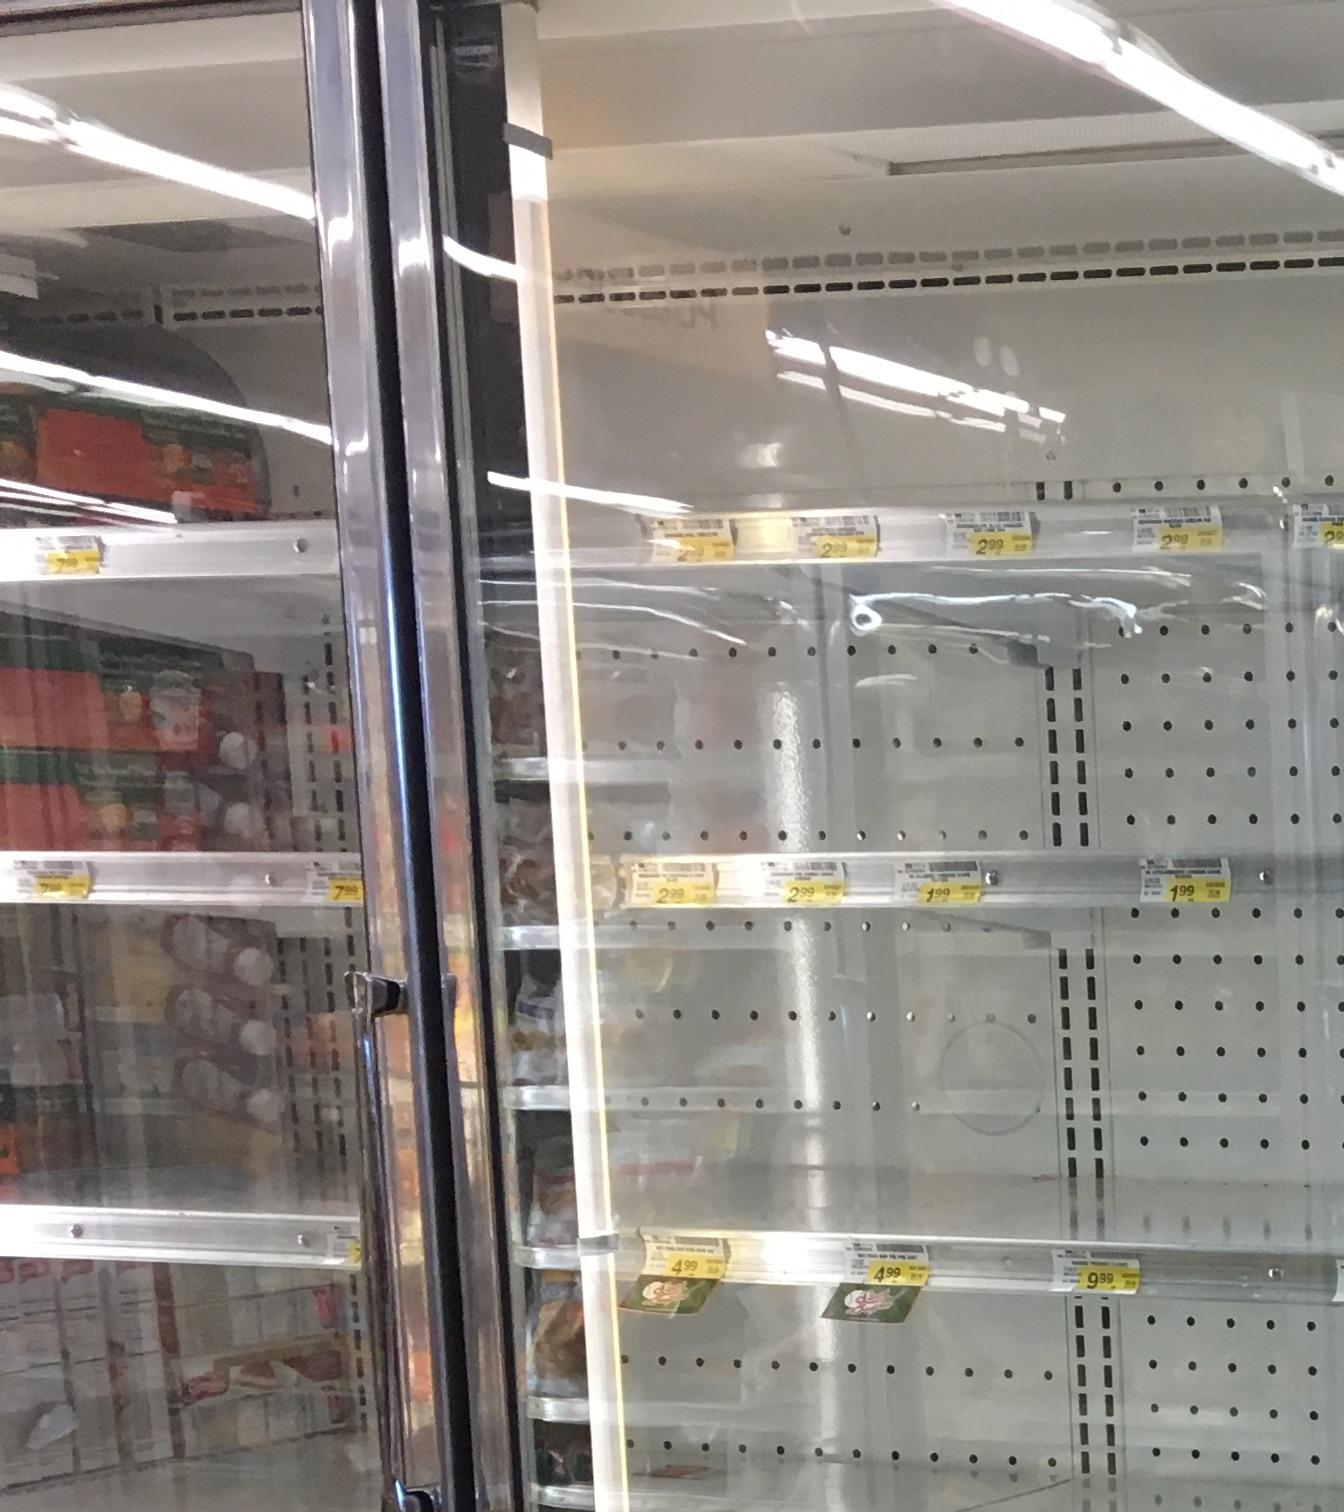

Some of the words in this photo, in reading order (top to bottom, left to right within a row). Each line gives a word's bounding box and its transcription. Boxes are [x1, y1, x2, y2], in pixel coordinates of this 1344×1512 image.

[976, 538, 1004, 555] 299
[787, 886, 815, 902] 299
[1170, 884, 1195, 902] 199
[671, 1259, 697, 1276] 499
[873, 1266, 901, 1282] 499
[1086, 1272, 1114, 1290] 999
